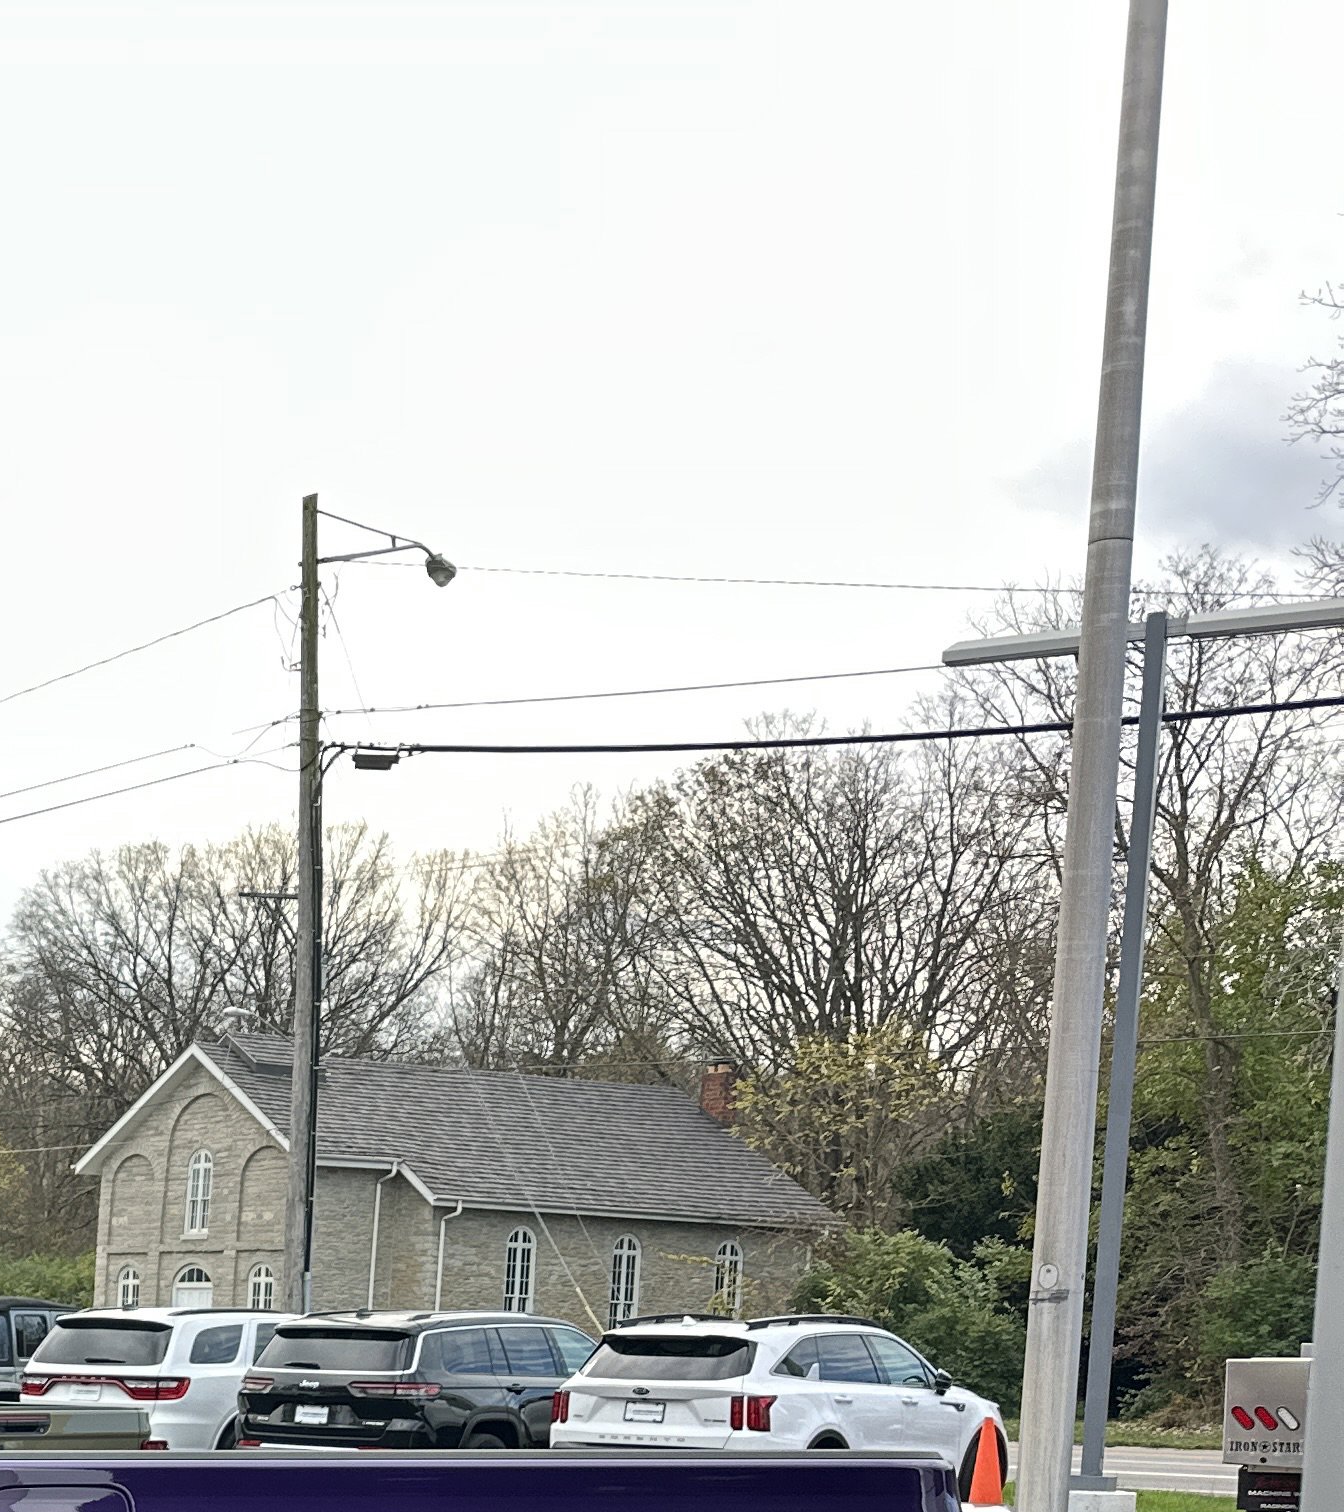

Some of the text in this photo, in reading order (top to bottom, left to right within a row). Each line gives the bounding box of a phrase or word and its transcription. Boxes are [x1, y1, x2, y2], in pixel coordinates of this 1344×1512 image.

[298, 1379, 320, 1389] Jeep
[1230, 1441, 1300, 1453] IRON STAR
